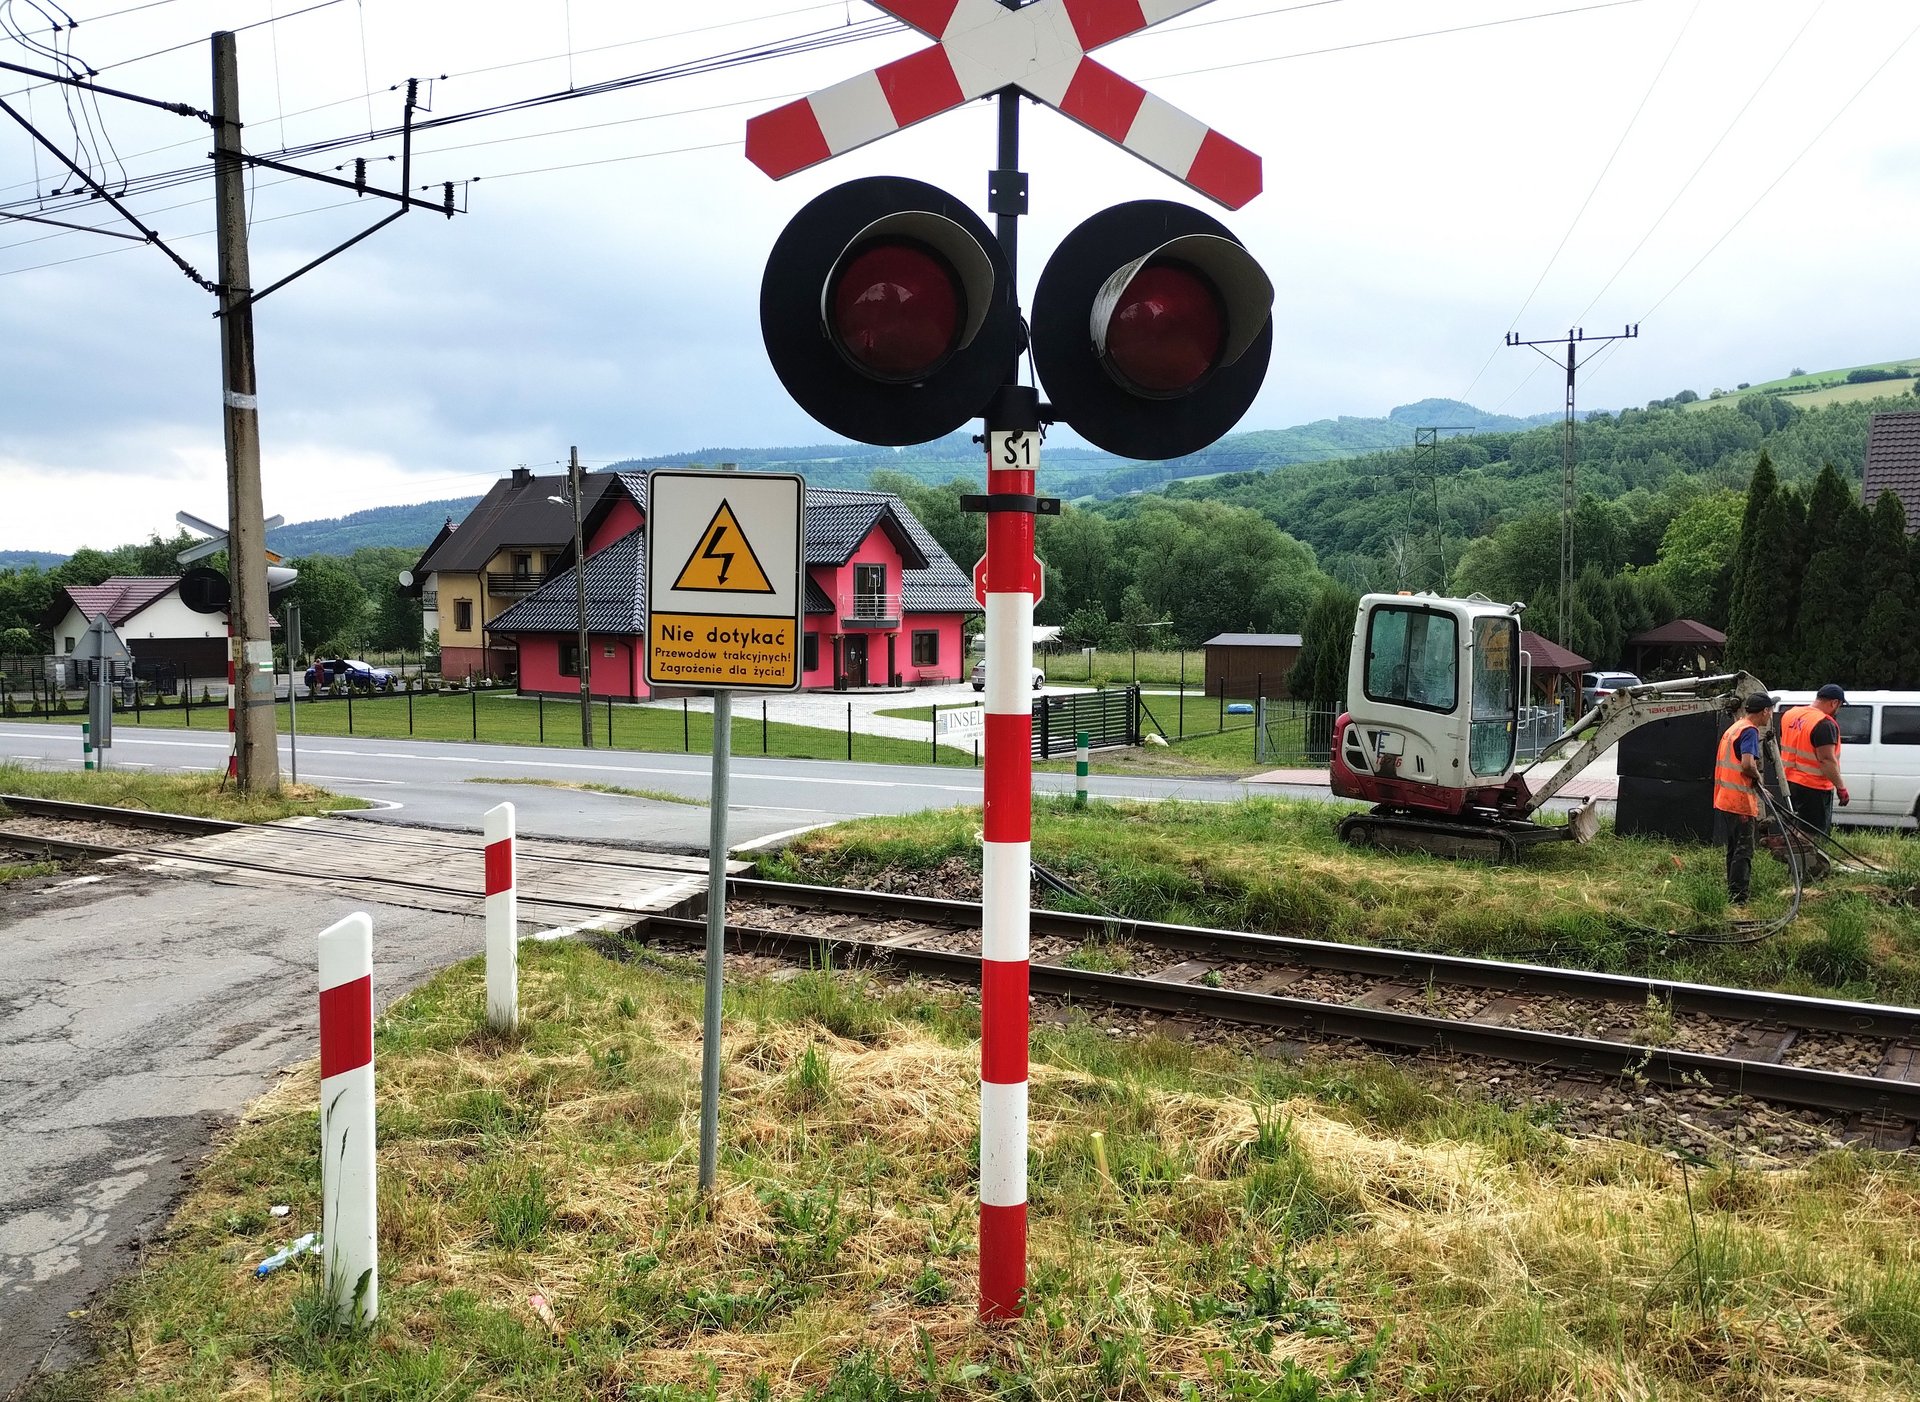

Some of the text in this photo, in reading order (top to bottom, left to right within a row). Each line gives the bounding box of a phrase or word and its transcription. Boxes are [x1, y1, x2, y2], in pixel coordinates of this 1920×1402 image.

[661, 624, 785, 648] Nie dotykać
[655, 647, 791, 664] Przewodów trakcyjnych!
[660, 662, 785, 678] Zagrożenie dla życia!
